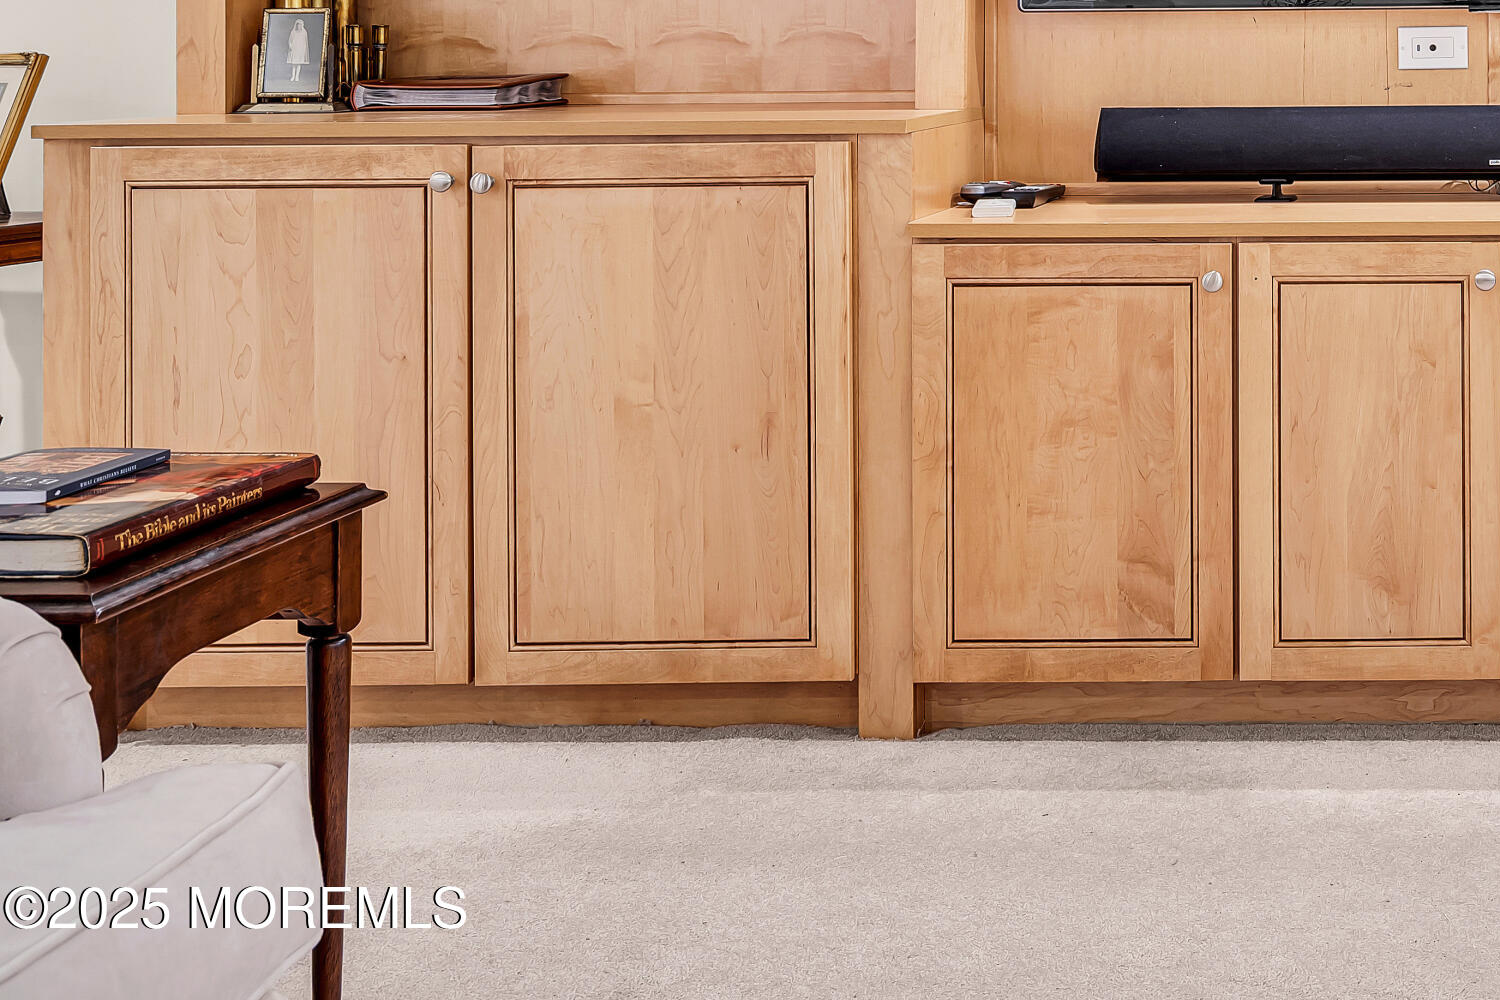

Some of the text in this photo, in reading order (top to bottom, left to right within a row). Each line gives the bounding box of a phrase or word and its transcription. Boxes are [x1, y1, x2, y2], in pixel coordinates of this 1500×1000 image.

[79, 464, 137, 488] WHAT CHRISTIANS BELIEVE
[114, 485, 264, 552] The Bible and its Painters
